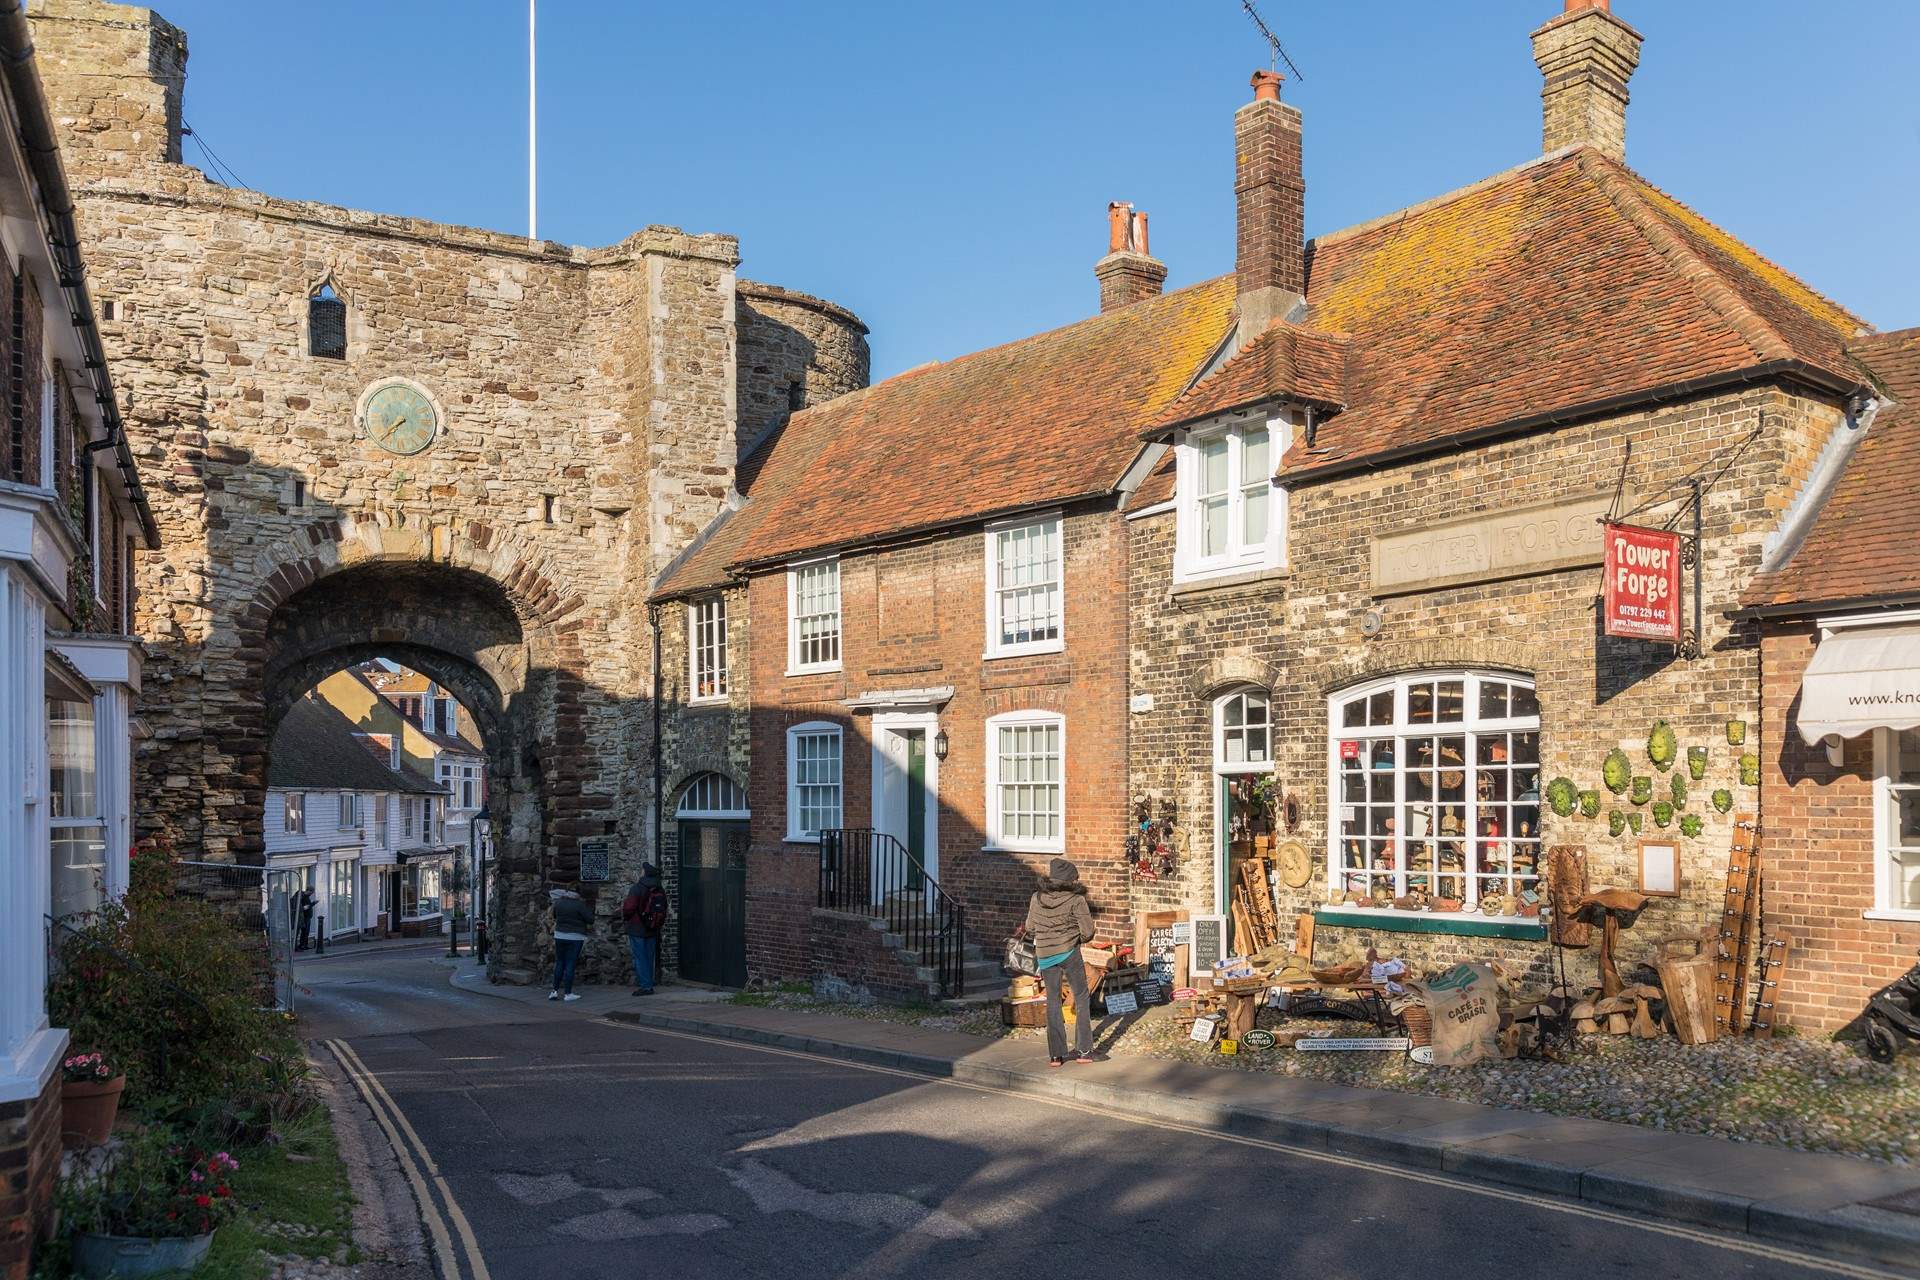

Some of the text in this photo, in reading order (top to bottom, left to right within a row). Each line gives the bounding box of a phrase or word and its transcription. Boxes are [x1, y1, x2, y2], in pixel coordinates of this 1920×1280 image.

[1387, 533, 1483, 572] TOWER
[1614, 538, 1670, 570] Tower
[1617, 567, 1668, 602] Forge
[1619, 605, 1666, 620] 01797 229 447
[1151, 928, 1173, 938] LARGE
[1197, 927, 1215, 936] OPEN
[1458, 1006, 1487, 1024] BRASIL
